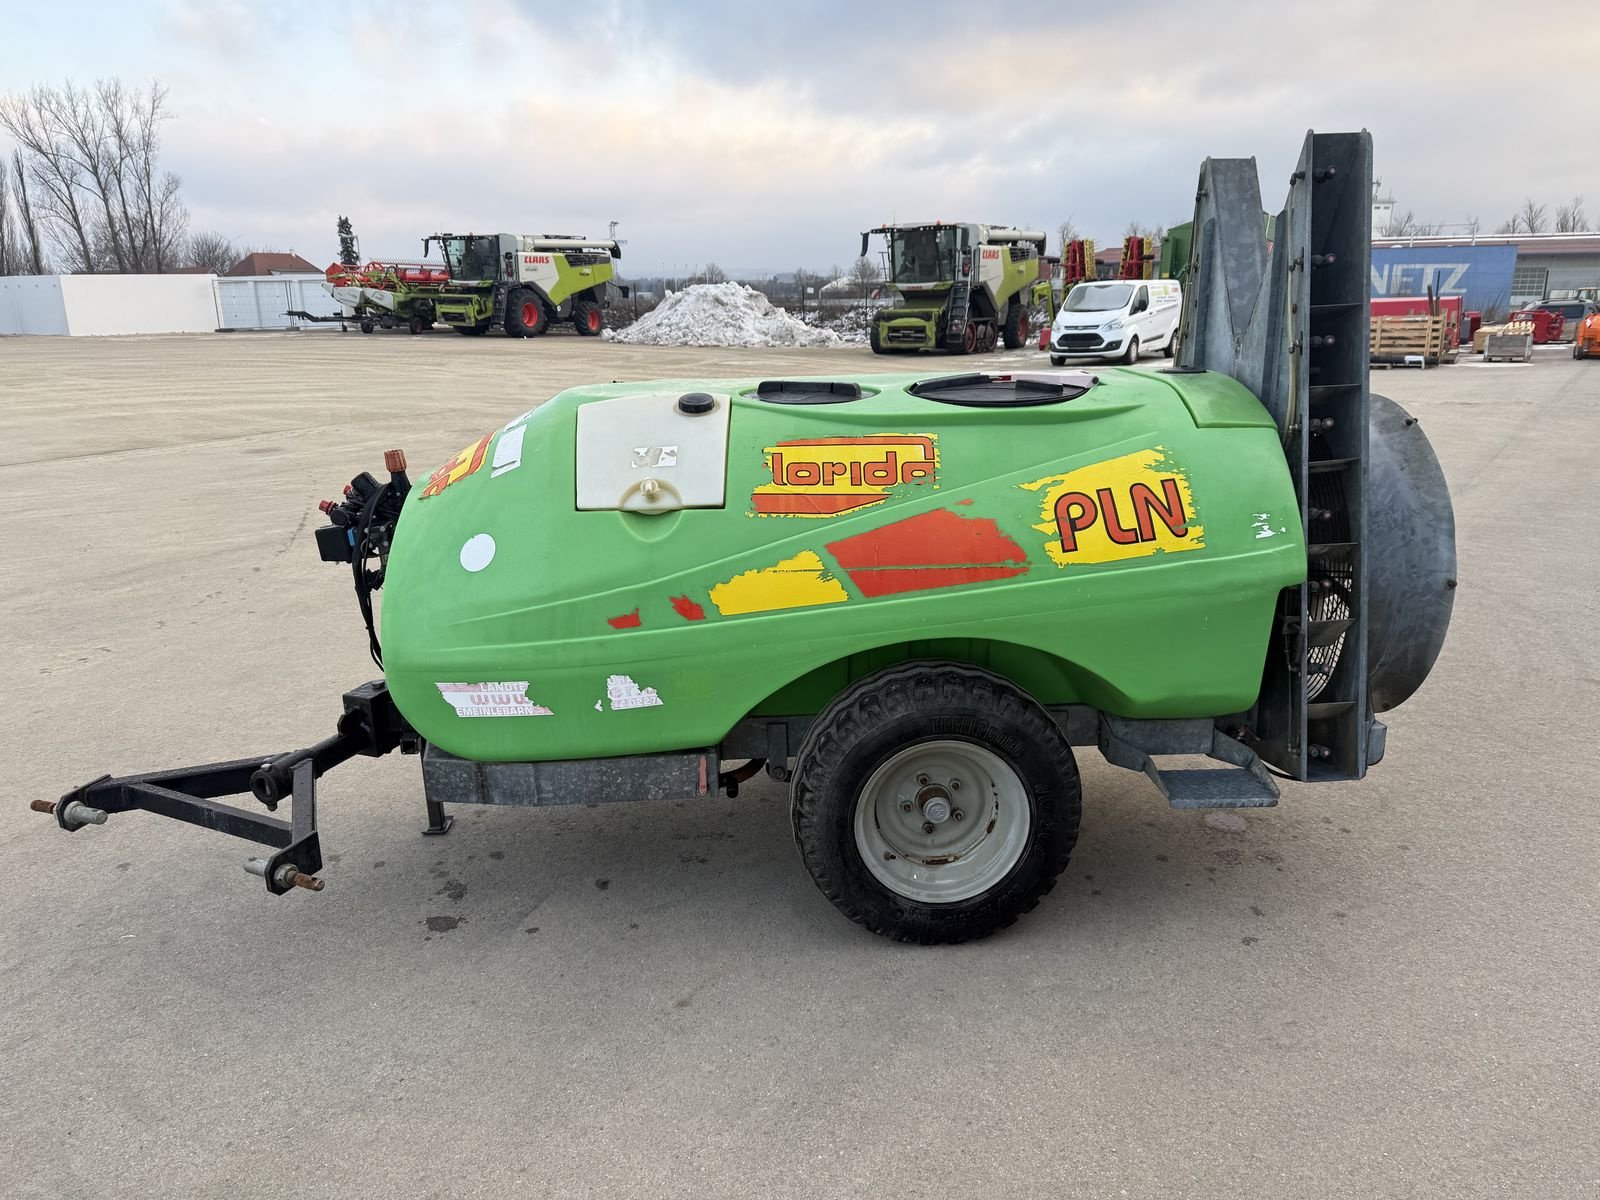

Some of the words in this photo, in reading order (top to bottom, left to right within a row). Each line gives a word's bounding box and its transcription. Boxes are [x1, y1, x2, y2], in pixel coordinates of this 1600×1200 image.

[524, 255, 550, 264] CLAAS
[982, 249, 1000, 259] CLAAS
[1371, 263, 1471, 295] NETZ
[1053, 477, 1189, 553] PLN
